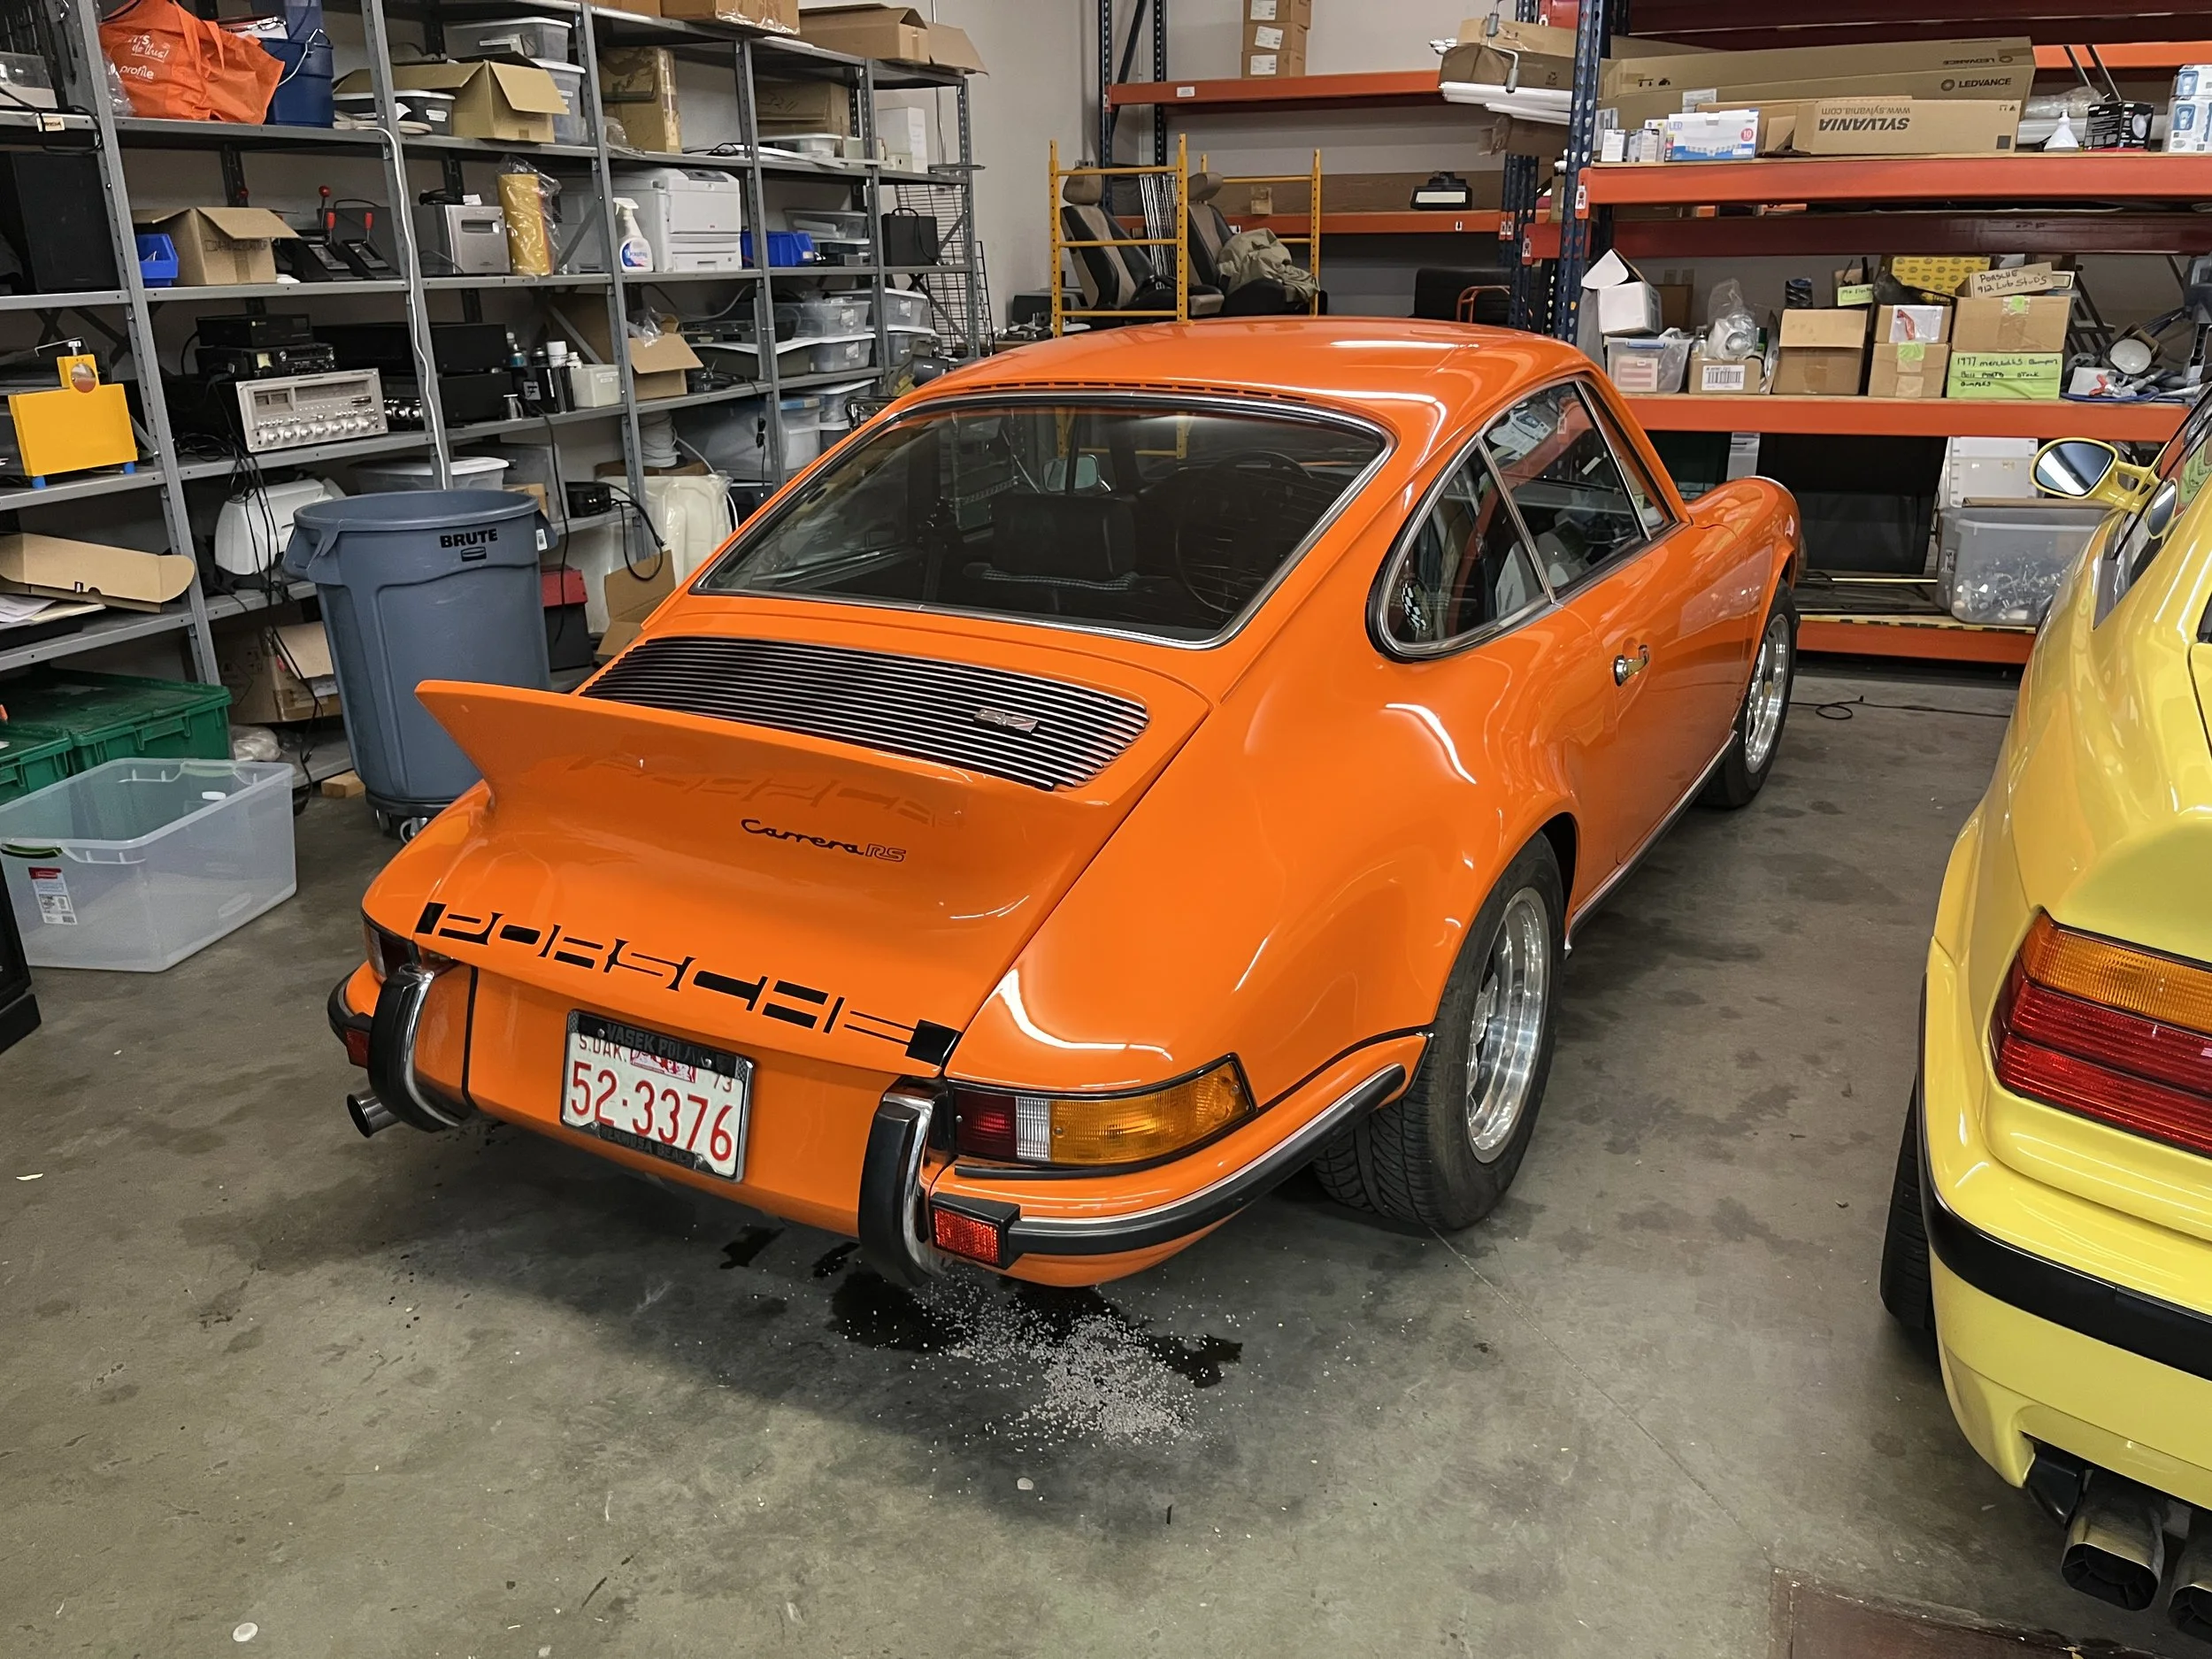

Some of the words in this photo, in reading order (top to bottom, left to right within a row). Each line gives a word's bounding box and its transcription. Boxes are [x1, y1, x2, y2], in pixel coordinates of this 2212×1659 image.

[119, 65, 155, 80] profile
[1958, 78, 2011, 88] LEDVANCE
[1821, 105, 1910, 115] www.sylvania.com
[1818, 118, 1910, 131] SYLVANIA
[1957, 357, 1977, 366] 1977
[439, 528, 498, 548] BRUTE
[741, 818, 864, 856] Carrera
[864, 842, 907, 863] RS
[415, 902, 963, 1064] PORSCHE
[606, 1023, 655, 1055] VASEK
